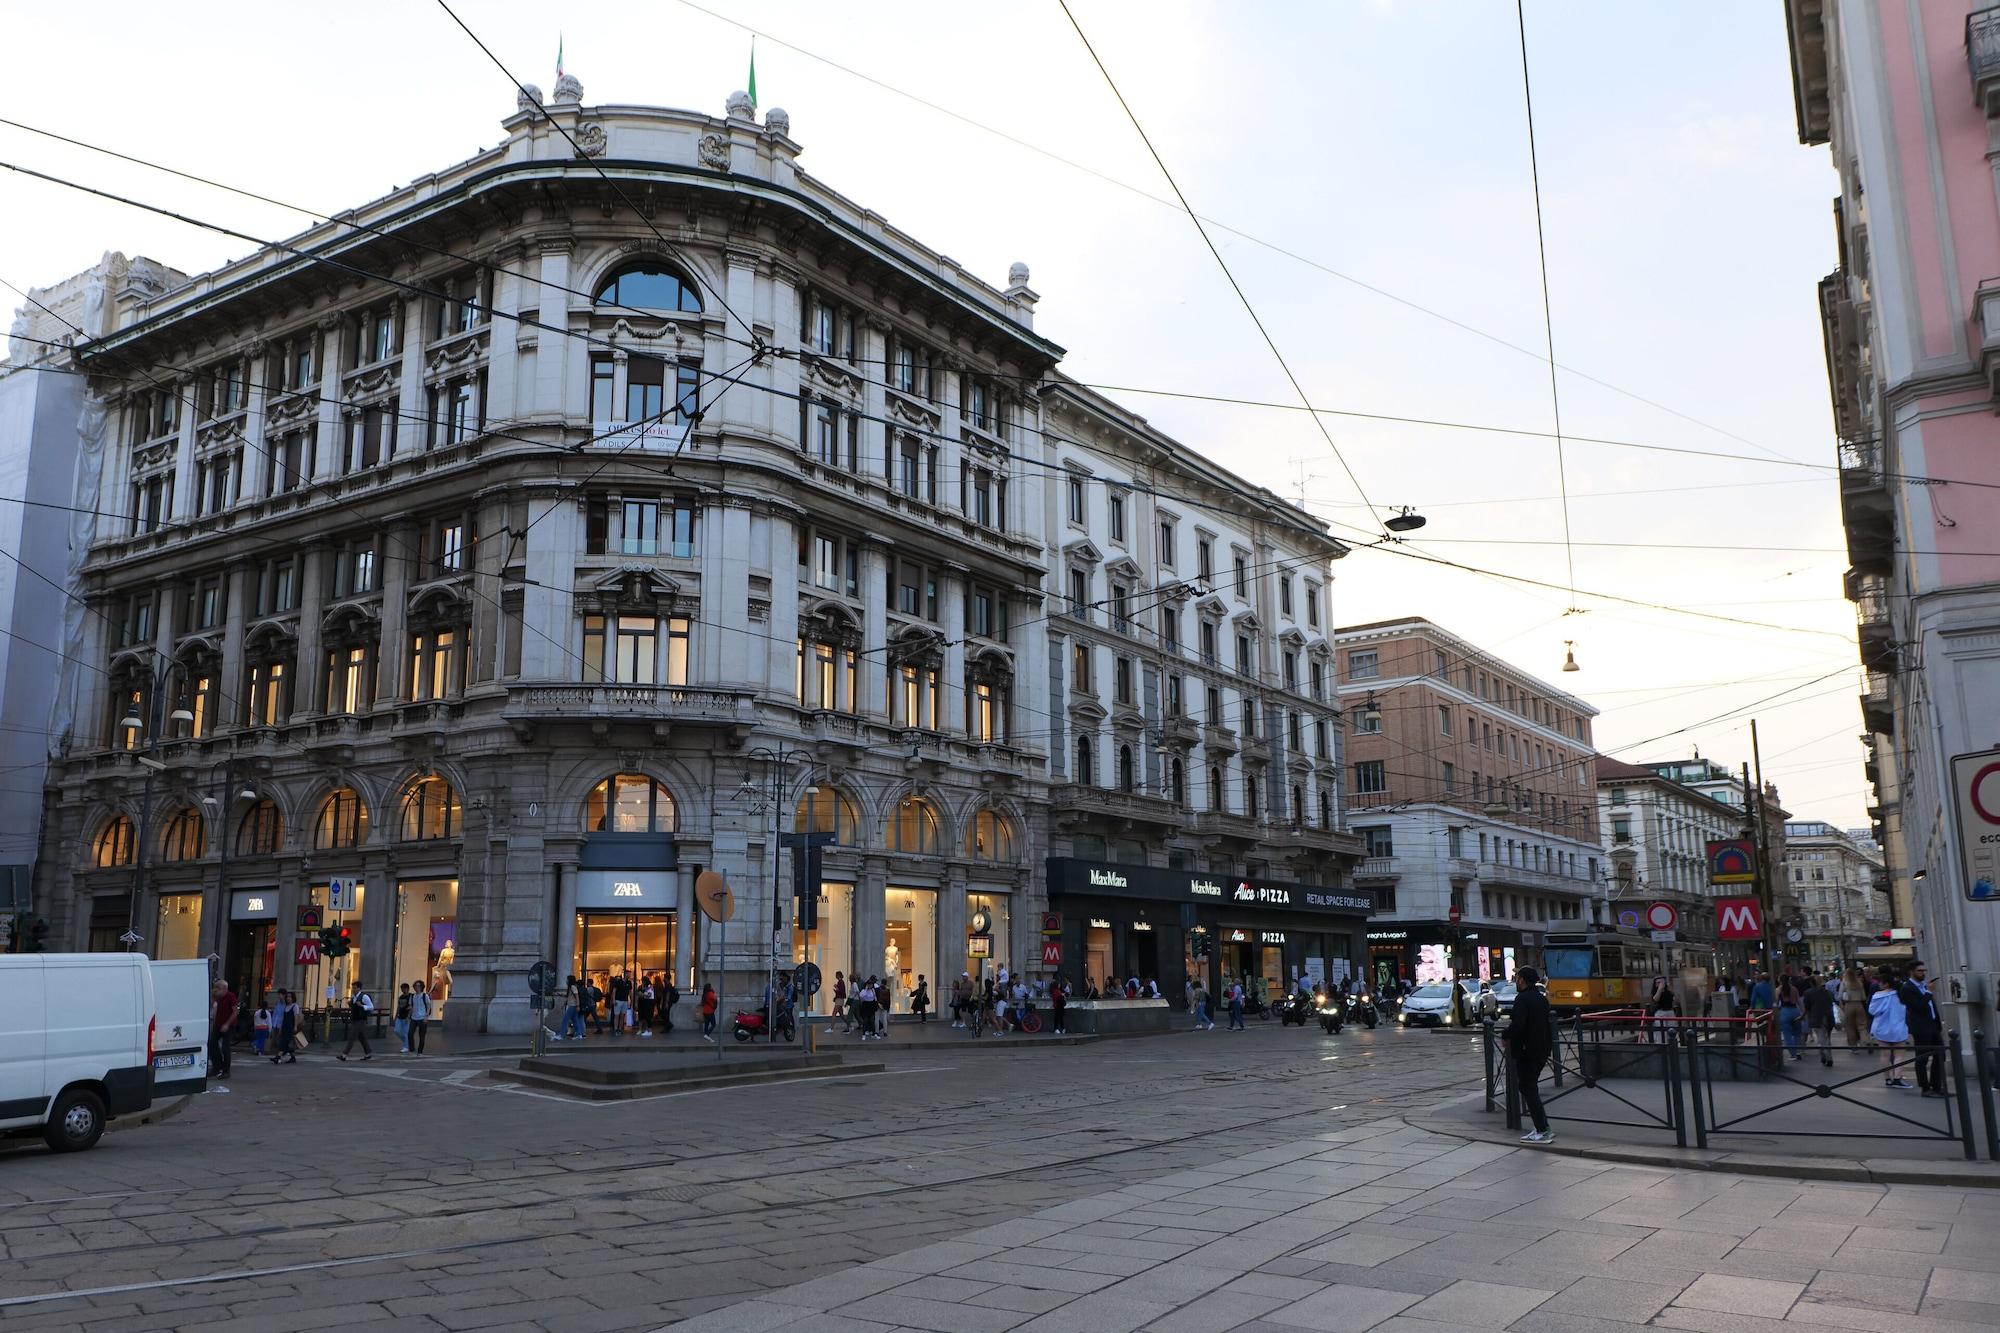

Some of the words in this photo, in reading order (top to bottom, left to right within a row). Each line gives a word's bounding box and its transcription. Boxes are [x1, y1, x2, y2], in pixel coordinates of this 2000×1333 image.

[608, 424, 642, 435] Offices
[658, 426, 669, 436] let
[608, 440, 626, 448] DILS
[1090, 869, 1127, 888] MaxMara
[614, 882, 643, 897] ZARA
[1191, 880, 1221, 896] MaxMara
[1234, 882, 1255, 901] Alice
[1260, 888, 1290, 904] PIZZA
[248, 898, 264, 911] ZARA
[1306, 893, 1325, 906] RETAIL
[1326, 896, 1344, 907] SPACE
[1344, 897, 1355, 908] FOR
[1355, 898, 1371, 909] LEASE
[1091, 918, 1111, 928] MaxMara
[1720, 906, 1758, 931] M
[1231, 929, 1245, 941] Alice
[1262, 932, 1286, 943] PIZZA
[299, 944, 318, 960] M
[1044, 946, 1060, 961] M
